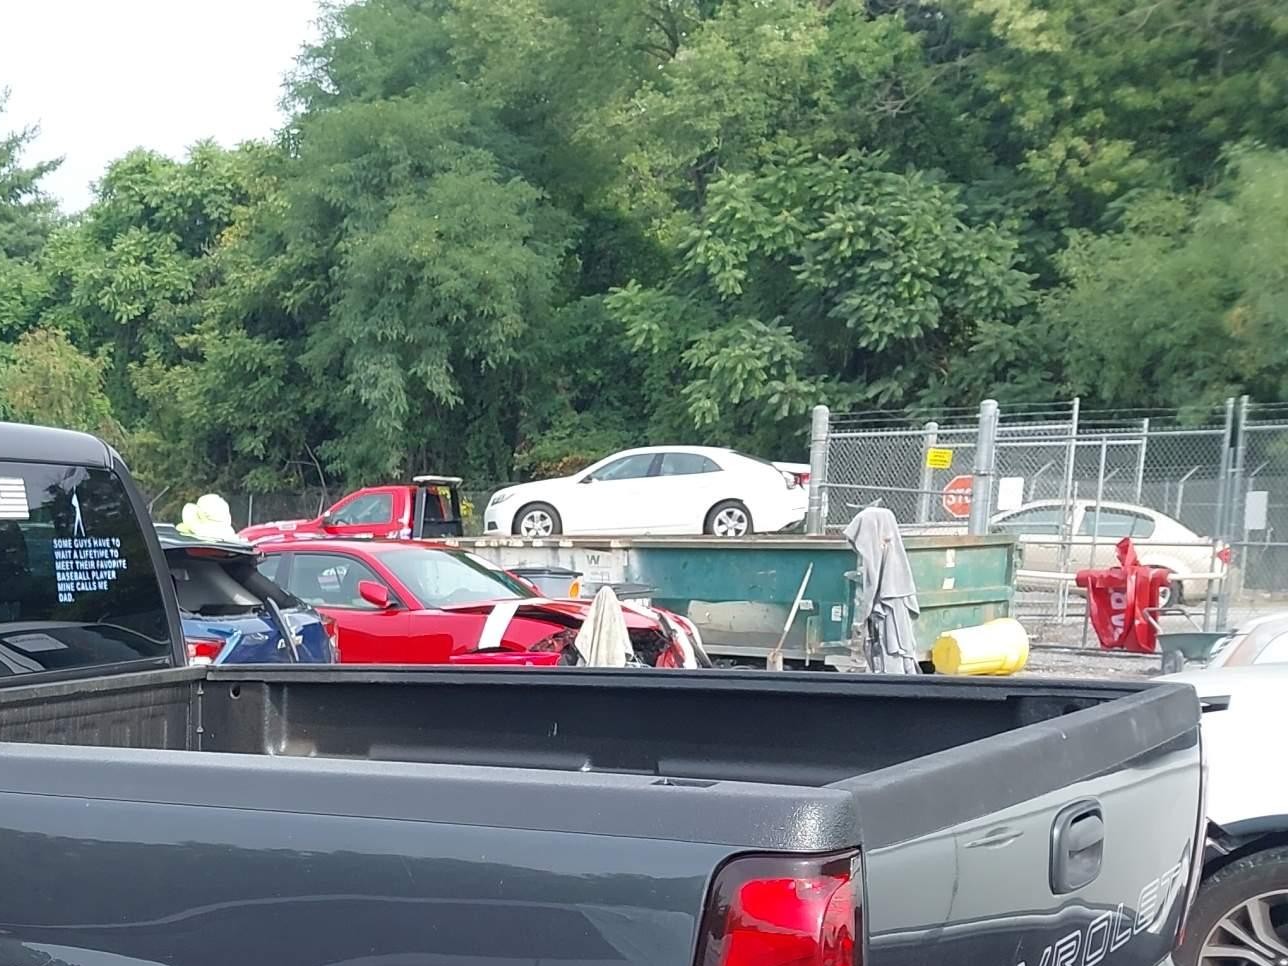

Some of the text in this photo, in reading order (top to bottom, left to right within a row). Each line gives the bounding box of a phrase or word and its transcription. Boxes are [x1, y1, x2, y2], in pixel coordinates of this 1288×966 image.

[946, 487, 973, 505] STO
[53, 537, 121, 549] SOME GUYS HAVE TO
[54, 548, 120, 560] WAIT A LIFETIME TO
[55, 559, 128, 571] MEET THEIR FAVORITE
[56, 570, 117, 582] BASEBALL PLAYER
[57, 580, 109, 592] MINE CALLS ME
